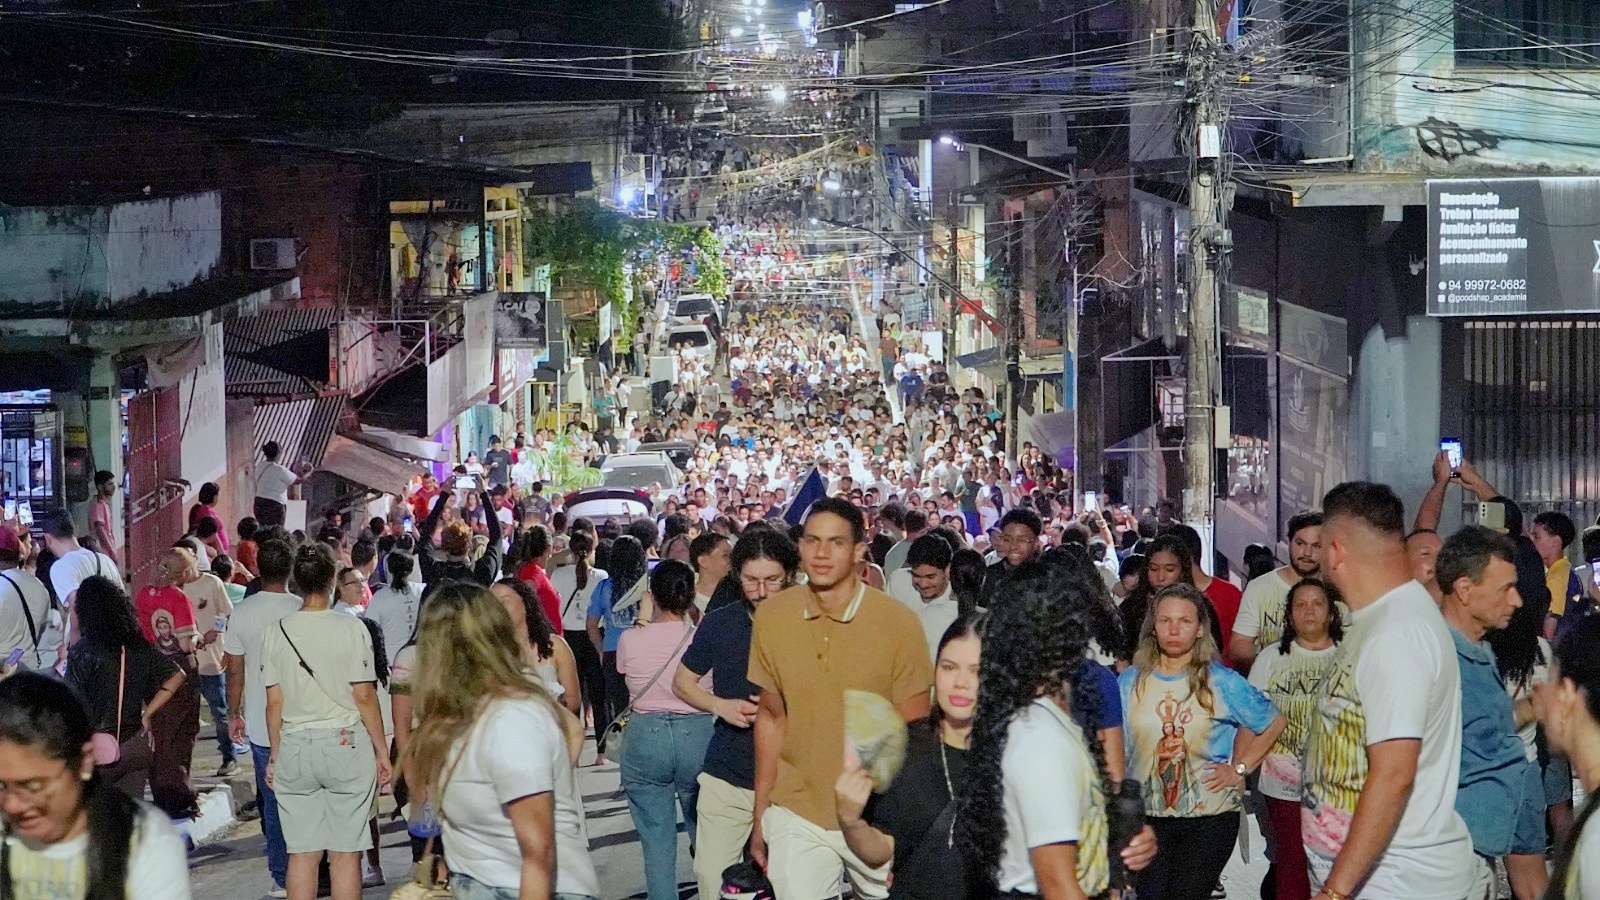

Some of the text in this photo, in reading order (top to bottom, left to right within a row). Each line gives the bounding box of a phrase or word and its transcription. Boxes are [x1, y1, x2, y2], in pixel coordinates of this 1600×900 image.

[1440, 192, 1500, 207] Musculação
[1440, 207, 1520, 220] Treino funcional
[1440, 222, 1488, 237] Avaliação
[1439, 237, 1528, 250] Acompanhamento
[1439, 251, 1509, 265] personalizado
[1448, 279, 1527, 291] 94 99972-0682
[1275, 678, 1321, 697] NAZ
